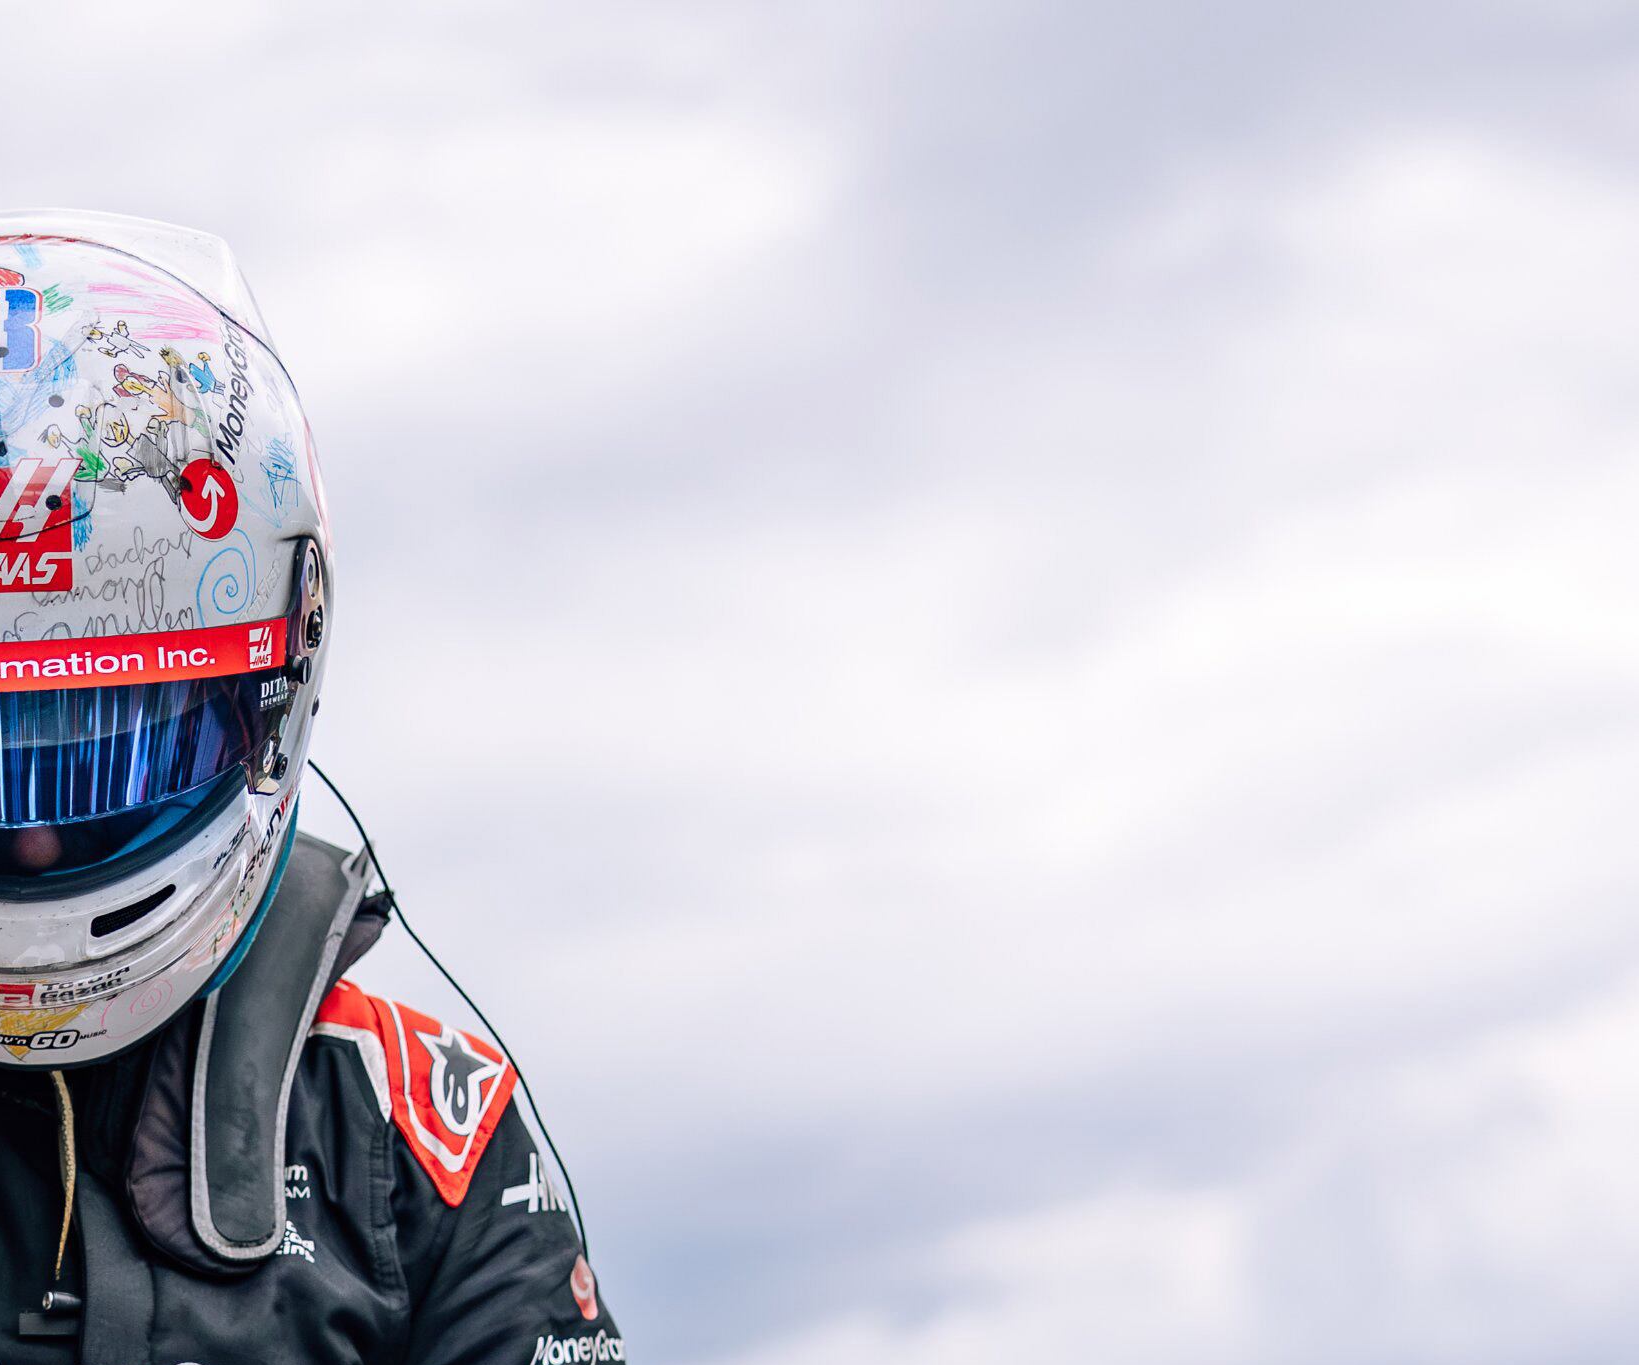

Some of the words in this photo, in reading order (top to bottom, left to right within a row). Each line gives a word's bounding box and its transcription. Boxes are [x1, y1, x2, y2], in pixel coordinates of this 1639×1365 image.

[158, 646, 217, 669] Inc.
[260, 676, 288, 699] DITA
[30, 1032, 77, 1048] GO
[79, 1028, 108, 1041] MUSIC
